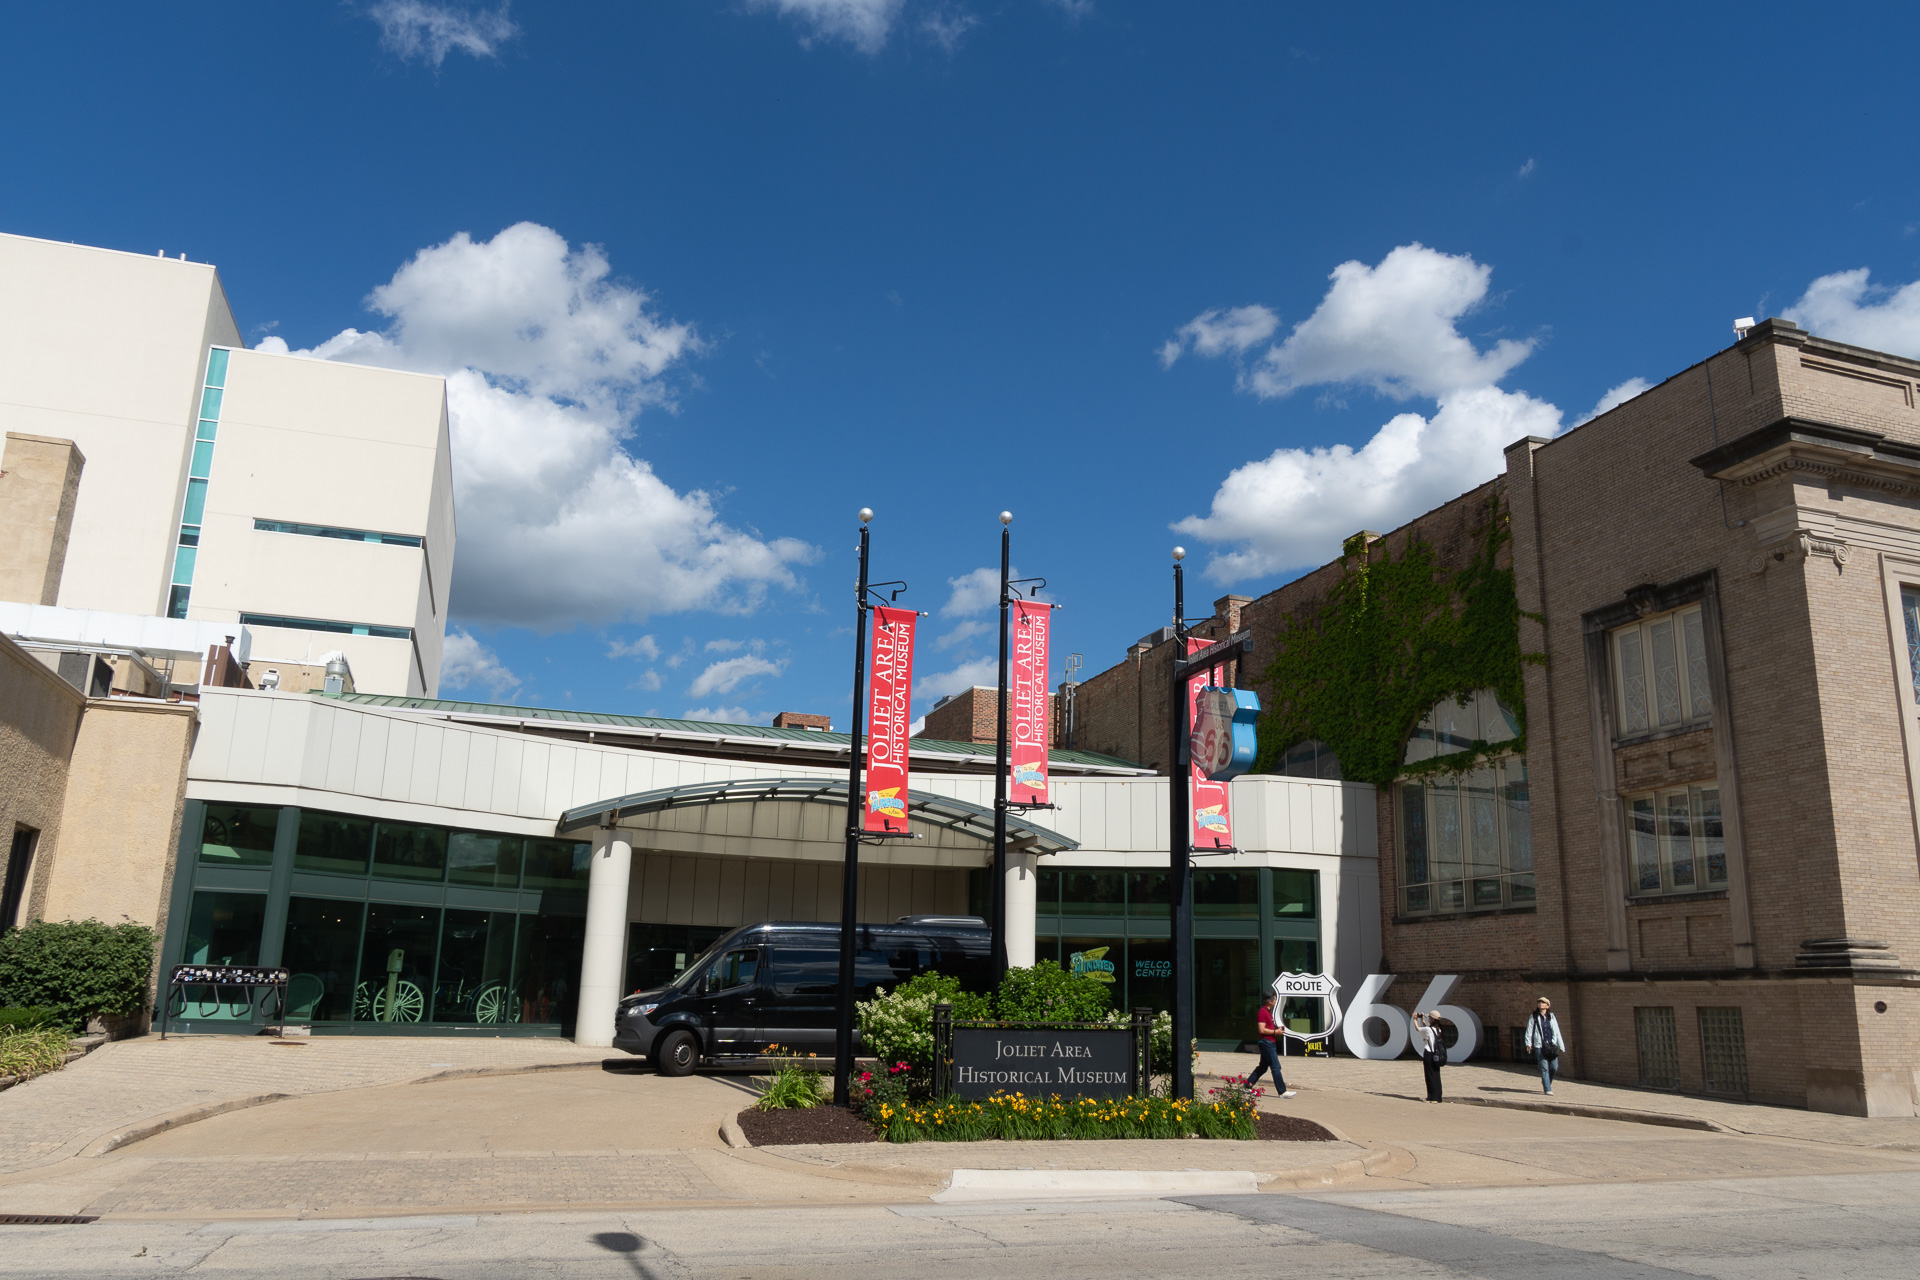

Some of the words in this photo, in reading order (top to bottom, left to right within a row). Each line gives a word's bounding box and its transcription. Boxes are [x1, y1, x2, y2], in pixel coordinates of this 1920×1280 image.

[875, 621, 896, 684] AREA
[896, 623, 911, 681] MUSEUM
[1017, 613, 1033, 671] AREA
[1035, 615, 1046, 667] MUSEUM
[1209, 635, 1231, 656] Historical
[1231, 629, 1251, 646] Museum
[871, 688, 904, 776] JOLIET
[893, 683, 906, 764] HISTORICAL
[1015, 674, 1044, 753] JOLIET
[1034, 669, 1044, 742] HISTORICAL
[1205, 729, 1231, 766] 66
[1135, 960, 1172, 969] WELCO
[1286, 981, 1322, 991] ROUTE
[1343, 974, 1479, 1063] 66
[957, 1066, 1053, 1083] HISTORICAL
[1057, 1066, 1127, 1084] MUSEUM
[995, 1040, 1047, 1060] JOLIET
[1050, 1041, 1092, 1058] AREA
